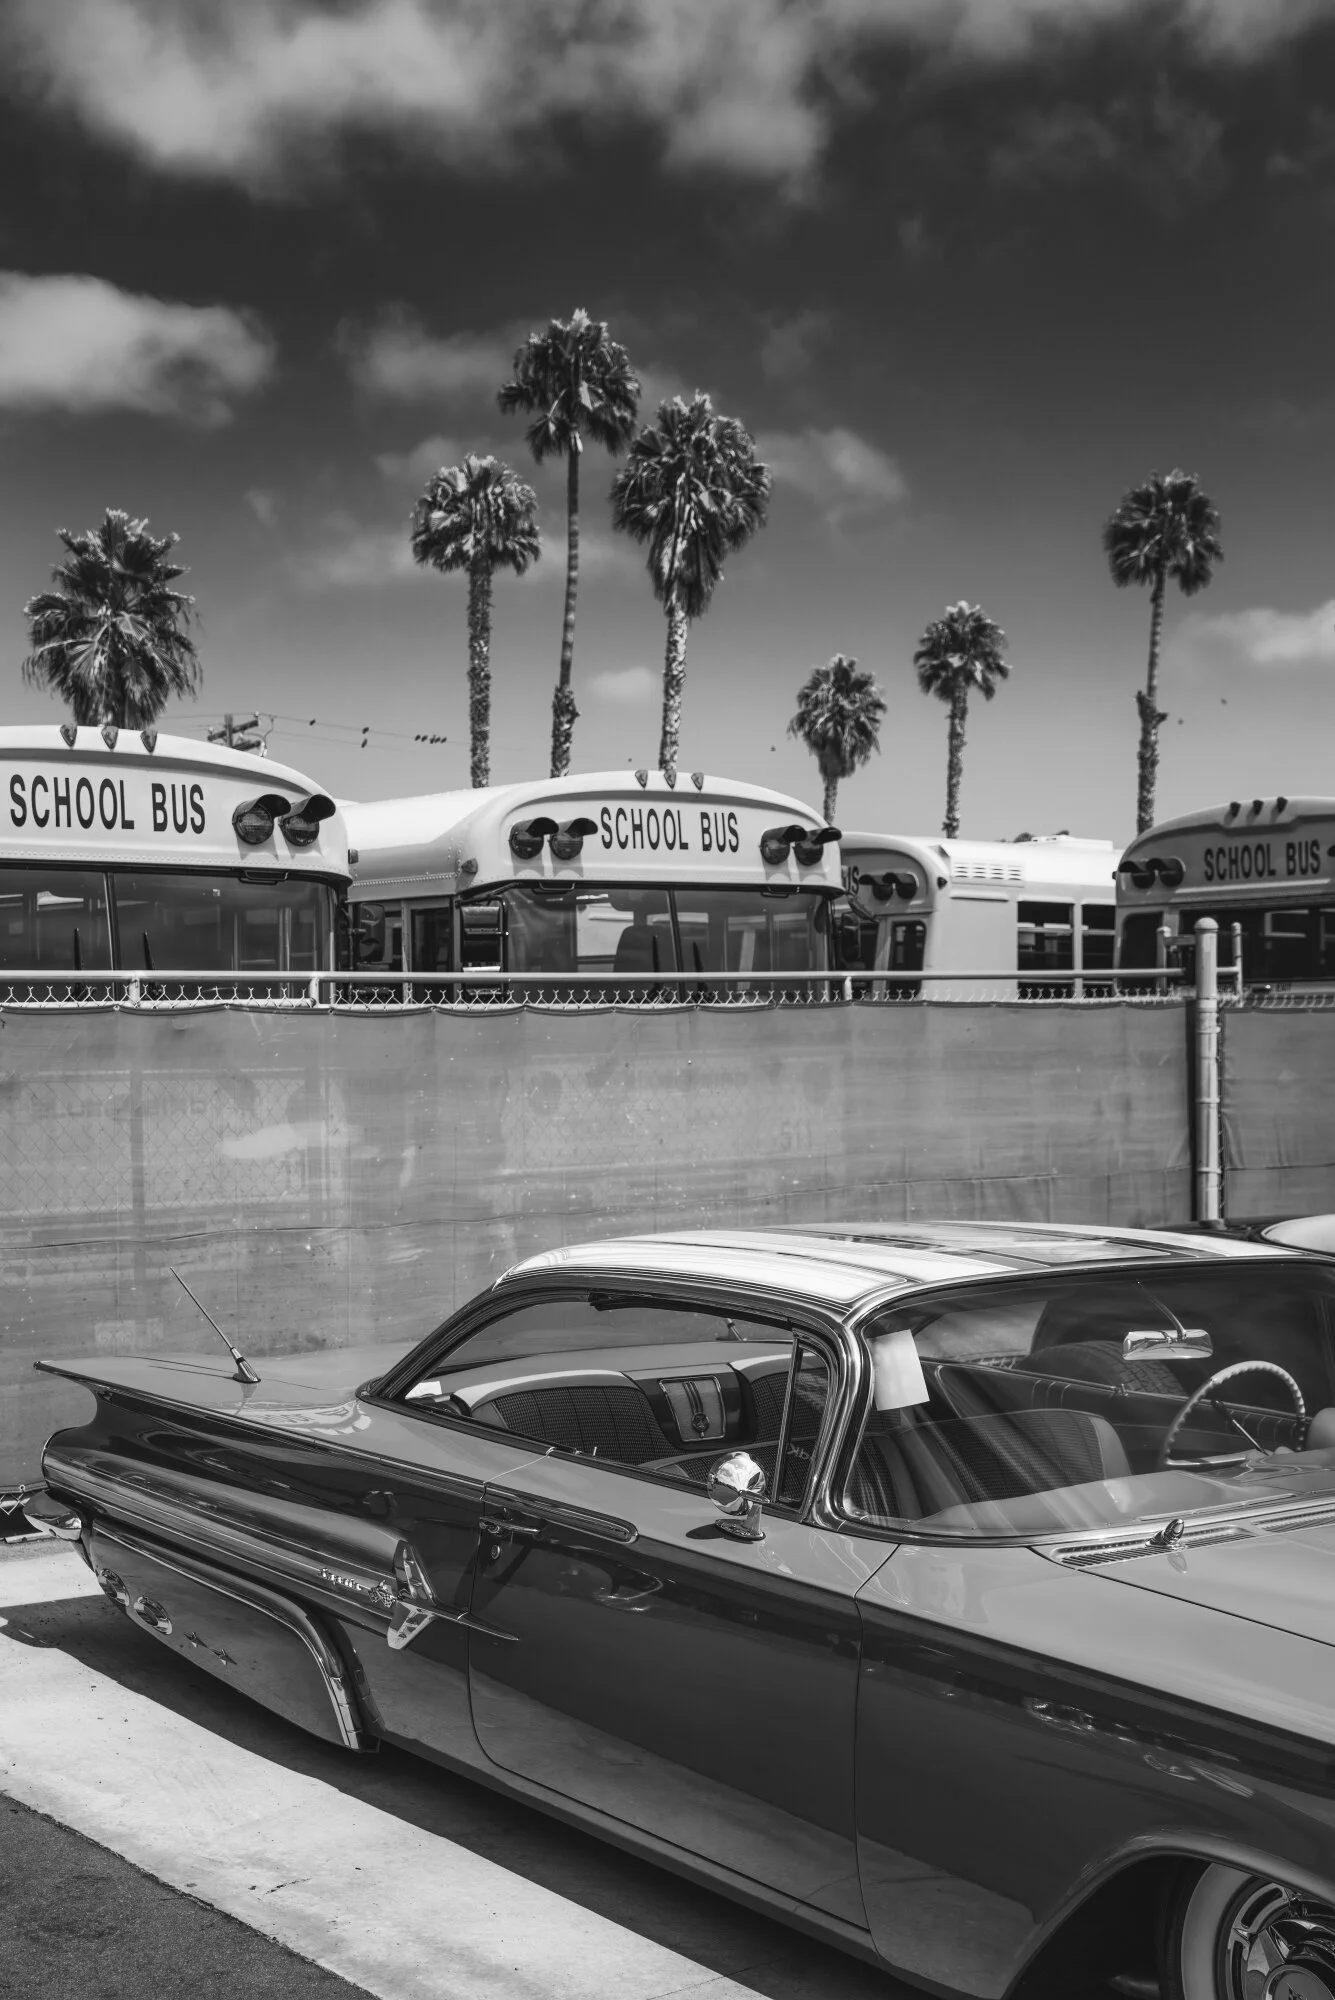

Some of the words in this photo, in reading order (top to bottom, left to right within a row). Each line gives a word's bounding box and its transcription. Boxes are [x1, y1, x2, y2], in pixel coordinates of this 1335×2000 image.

[9, 774, 135, 830] SCHOOL
[151, 782, 206, 835] BUS
[600, 806, 689, 851] SCHOOL
[700, 811, 739, 853] BUS
[1203, 843, 1277, 882] SCHOOL
[1285, 839, 1322, 877] BUS
